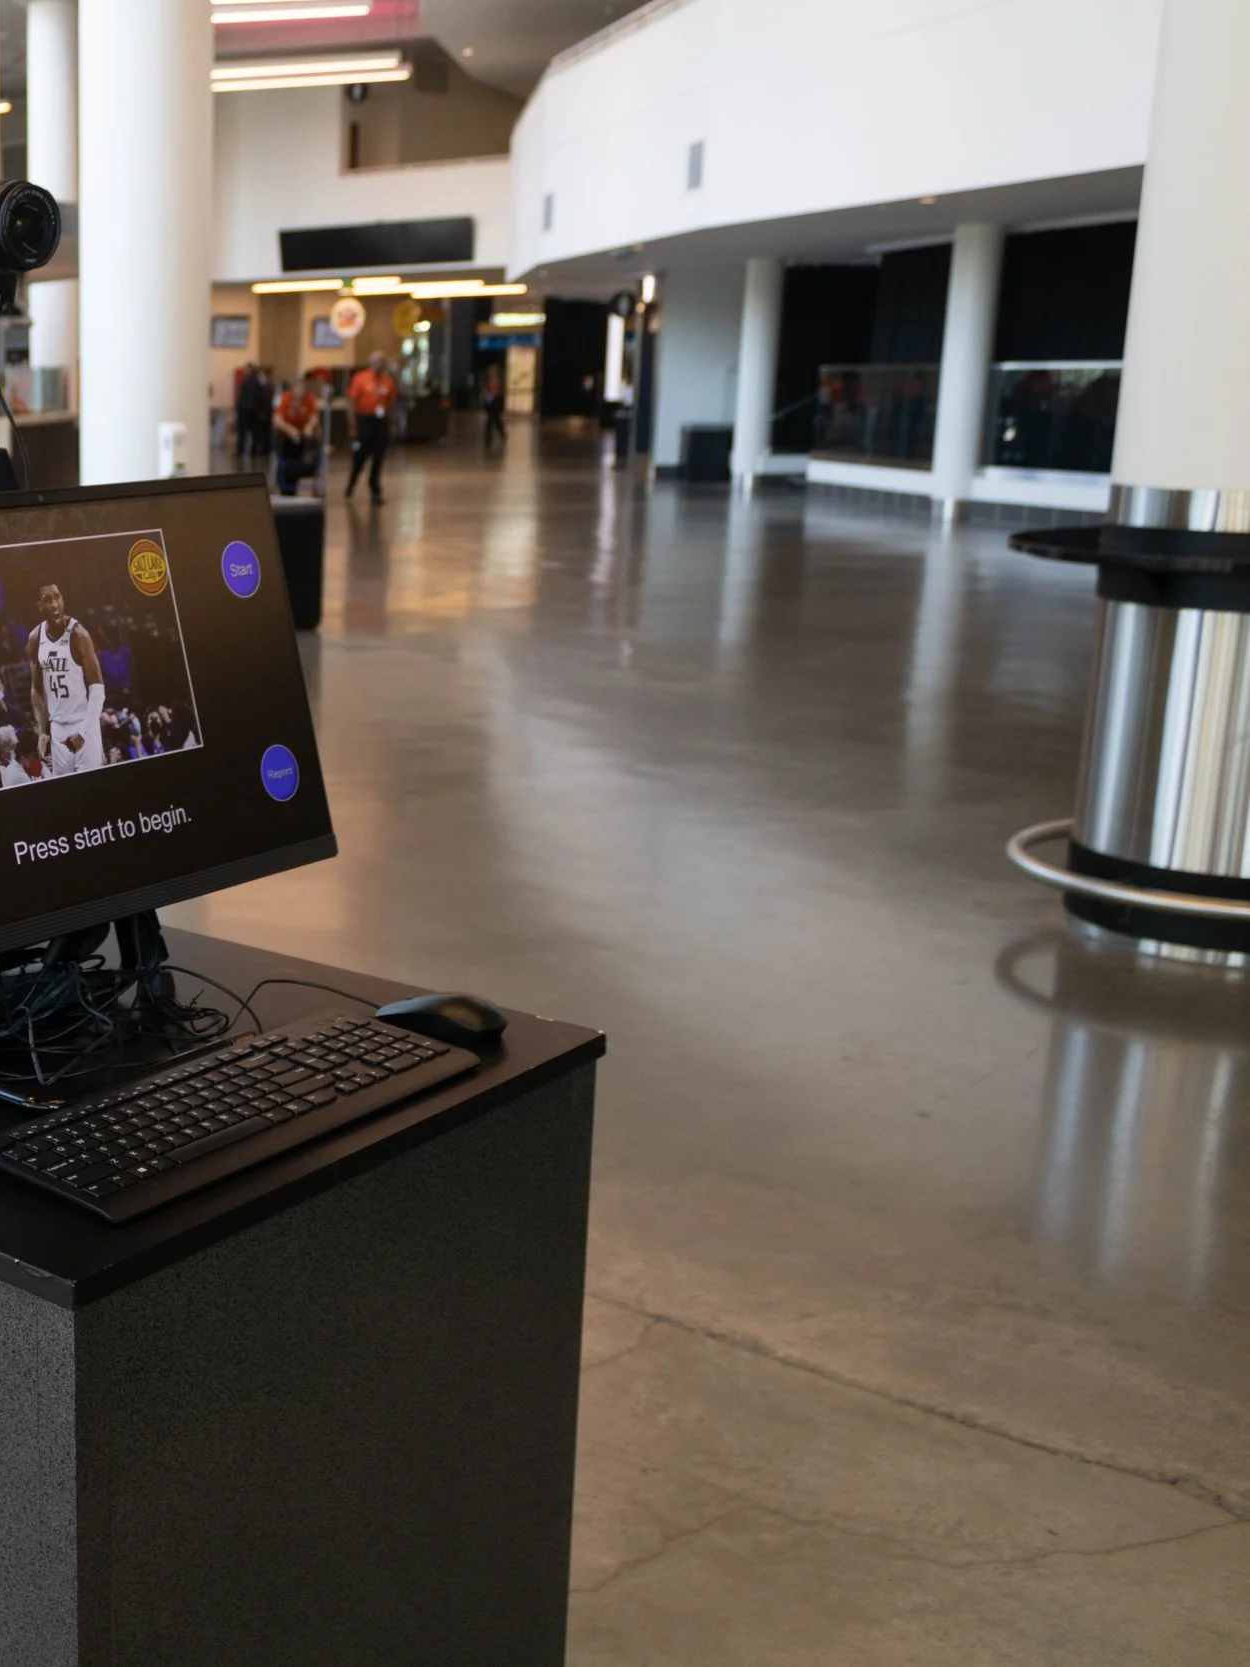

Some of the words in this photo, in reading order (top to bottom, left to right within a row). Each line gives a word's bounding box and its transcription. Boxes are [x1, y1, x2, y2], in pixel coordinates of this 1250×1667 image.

[229, 563, 254, 578] Start
[49, 674, 70, 699] 45
[13, 836, 70, 865] Press
[73, 821, 115, 850] start
[118, 818, 136, 839] to
[138, 804, 192, 834] begin.
